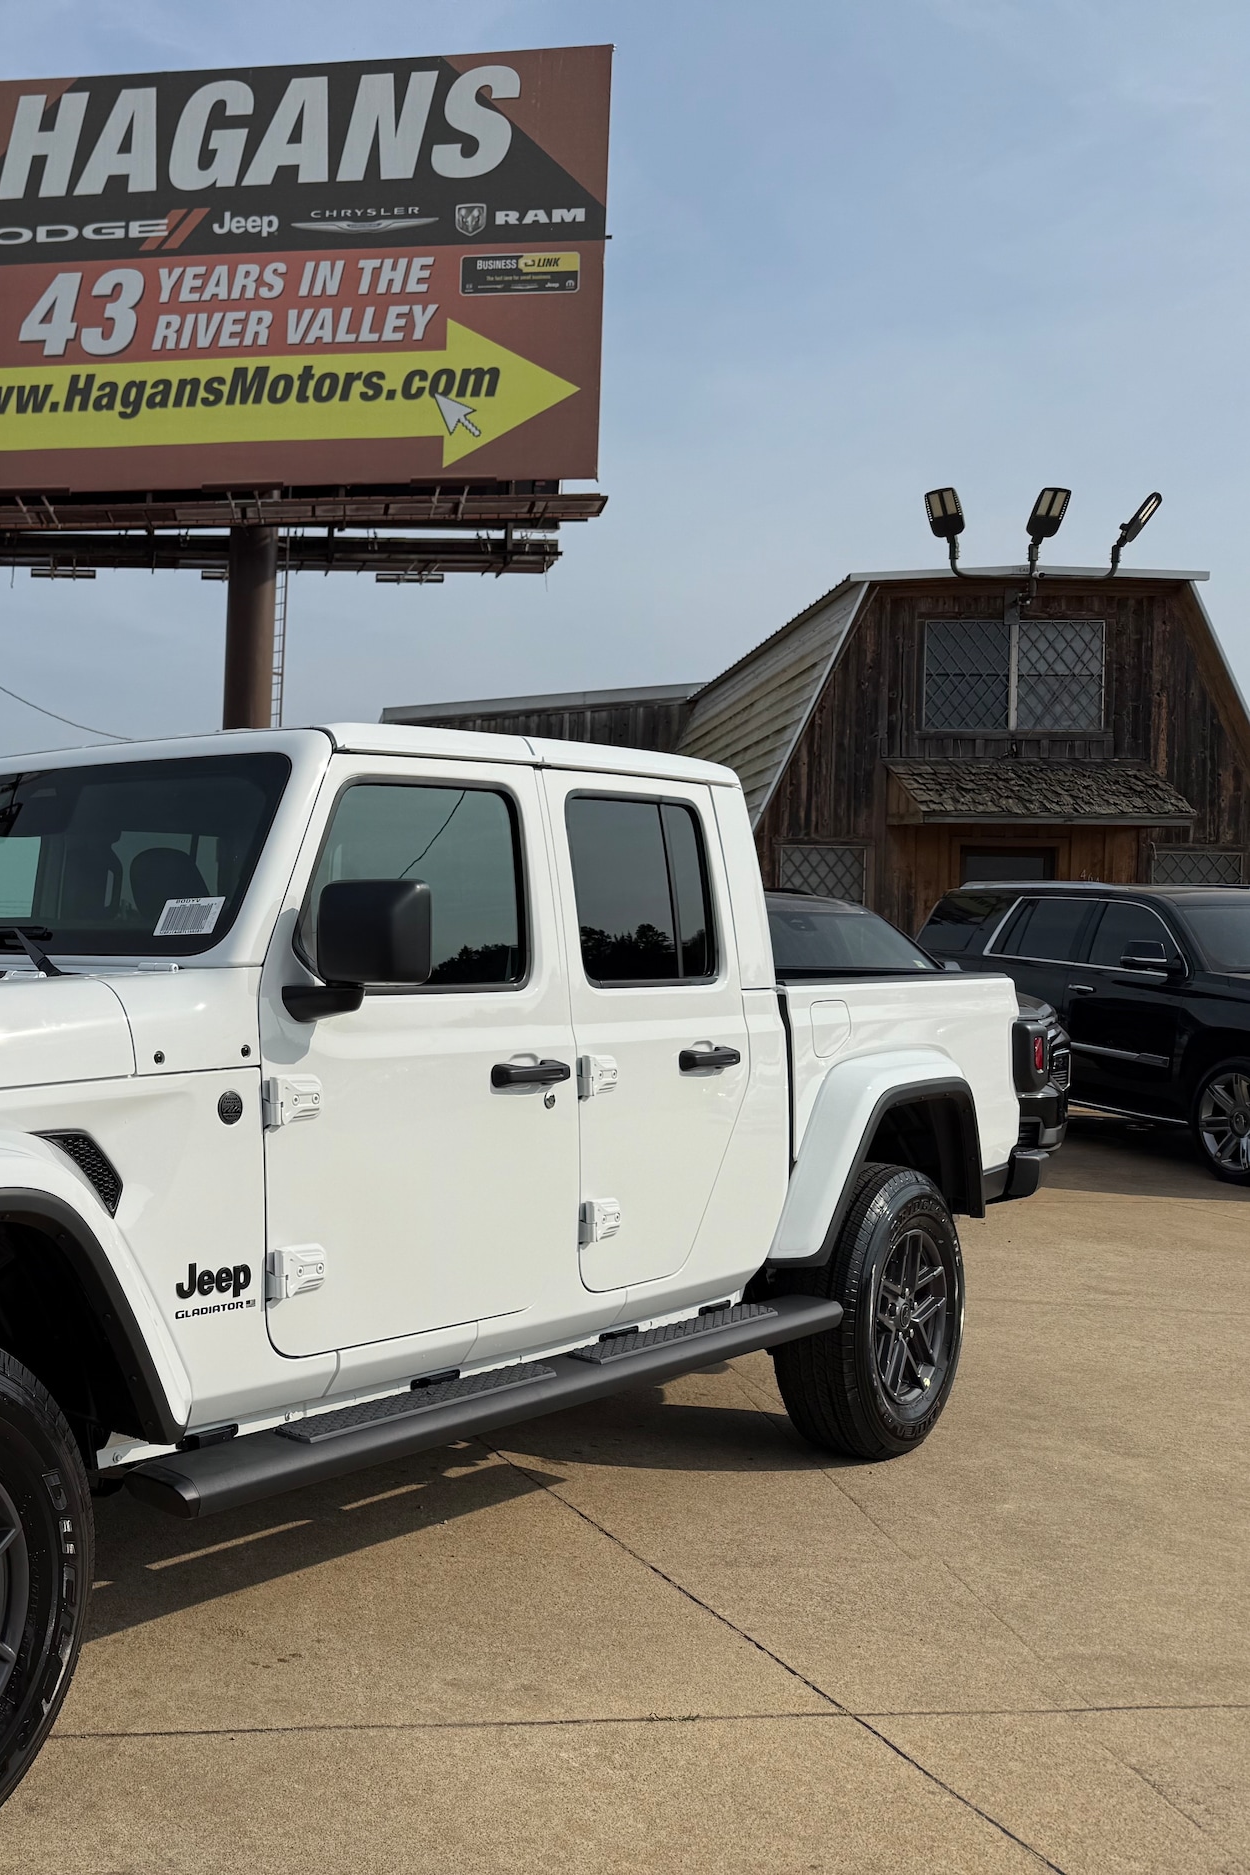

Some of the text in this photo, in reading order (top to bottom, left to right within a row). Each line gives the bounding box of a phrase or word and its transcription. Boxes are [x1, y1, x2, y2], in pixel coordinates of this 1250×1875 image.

[212, 211, 279, 237] Jeep
[311, 206, 420, 218] CHRYSLER
[495, 207, 586, 225] RAM
[476, 257, 561, 270] BUSINESS LINK
[158, 256, 435, 303] YEARS IN THE
[18, 269, 144, 356] 43
[152, 304, 439, 351] RIVER VALLEY
[176, 1262, 252, 1299] Jeep
[175, 1301, 244, 1319] GLADIATOR
